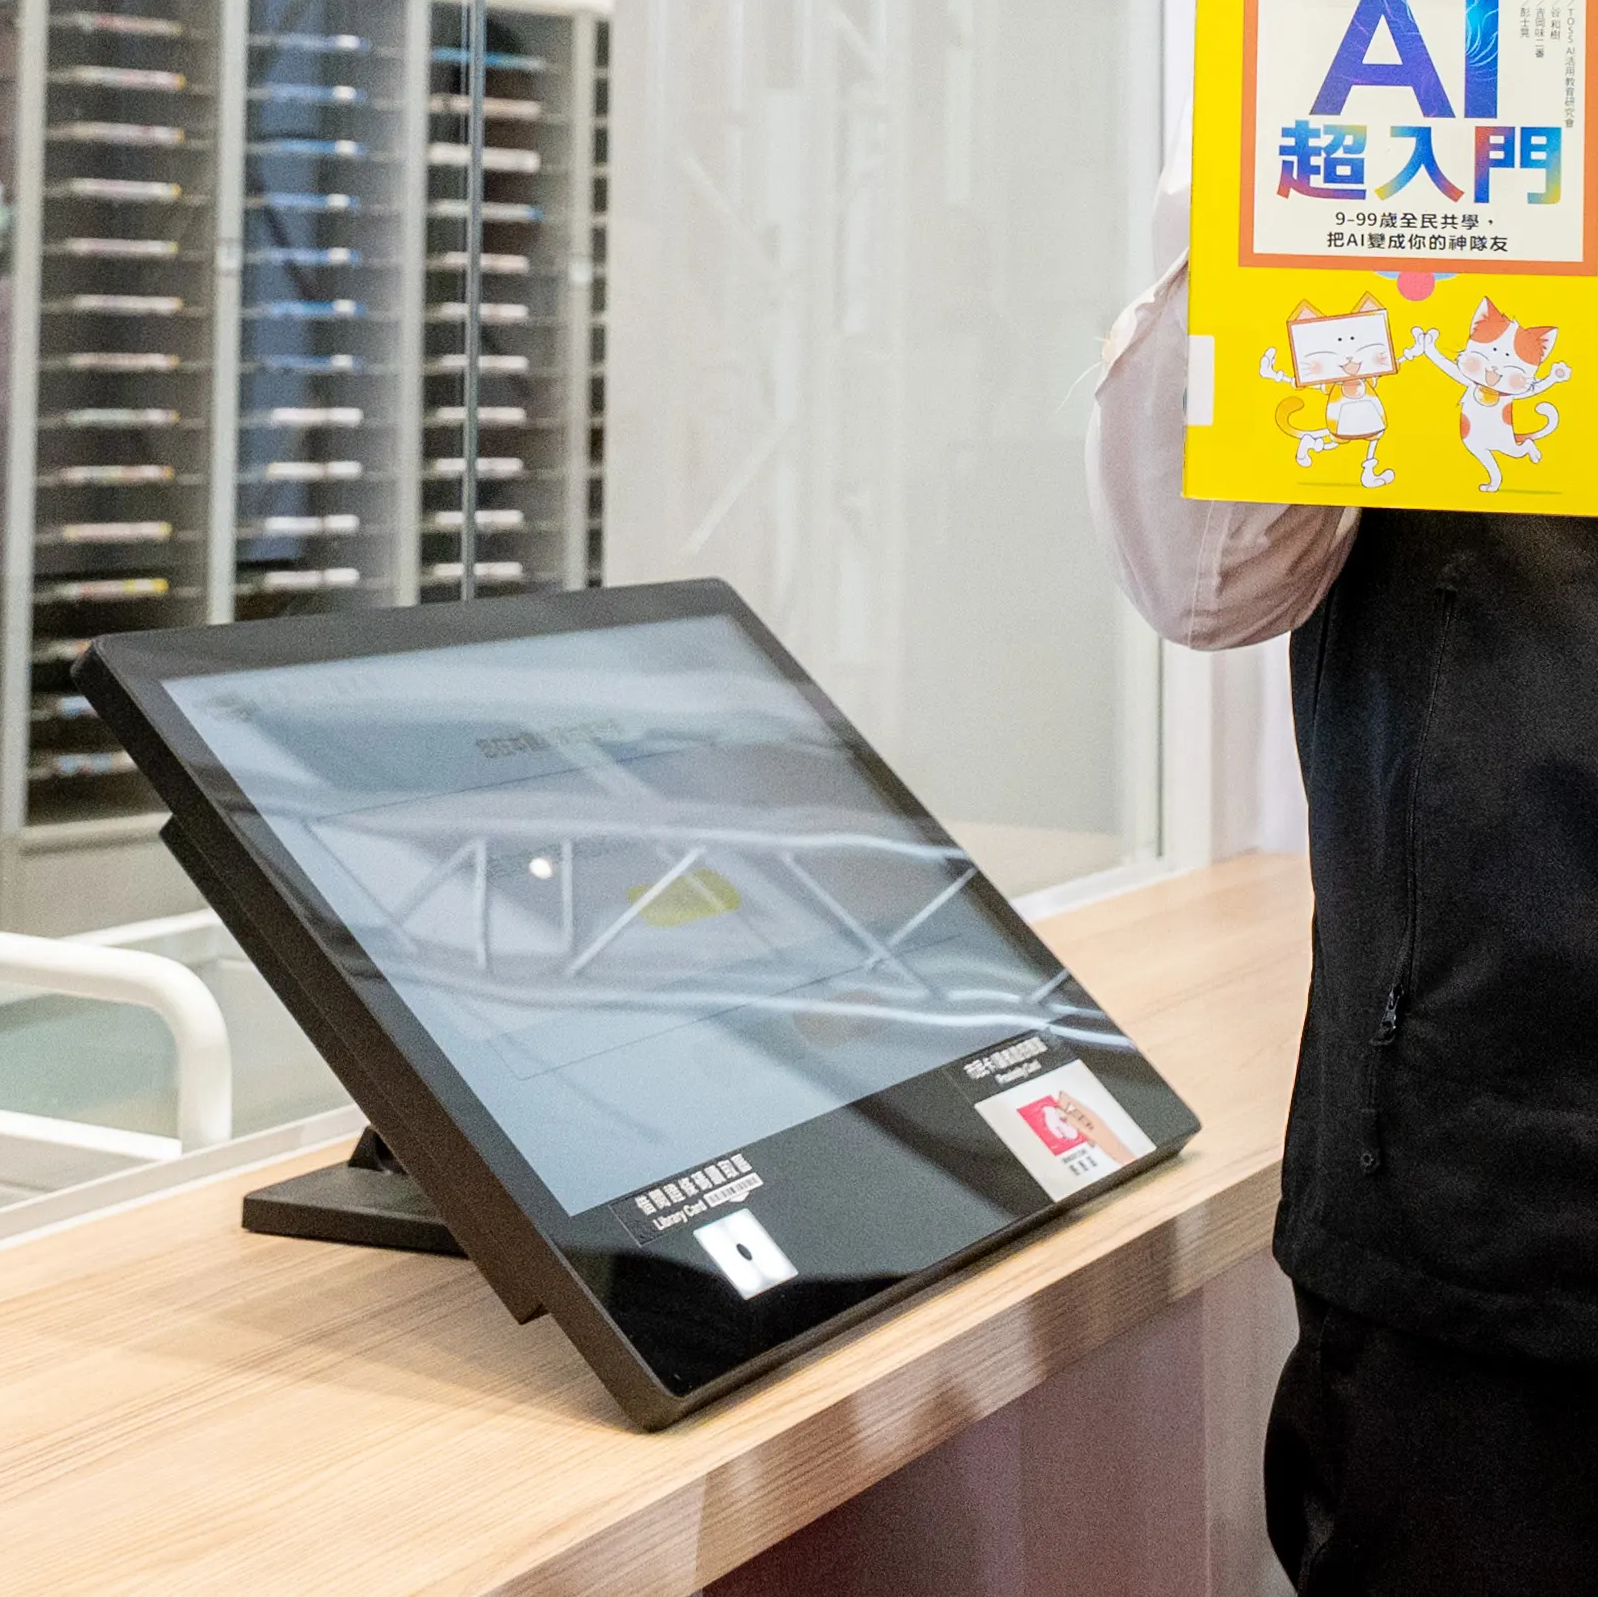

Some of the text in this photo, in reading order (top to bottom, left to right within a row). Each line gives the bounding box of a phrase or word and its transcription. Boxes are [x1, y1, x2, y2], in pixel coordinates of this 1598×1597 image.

[1276, 120, 1563, 205] 超入門
[1327, 231, 1508, 252] 把AI變成你的神隊友
[653, 1199, 708, 1231] Library Card
